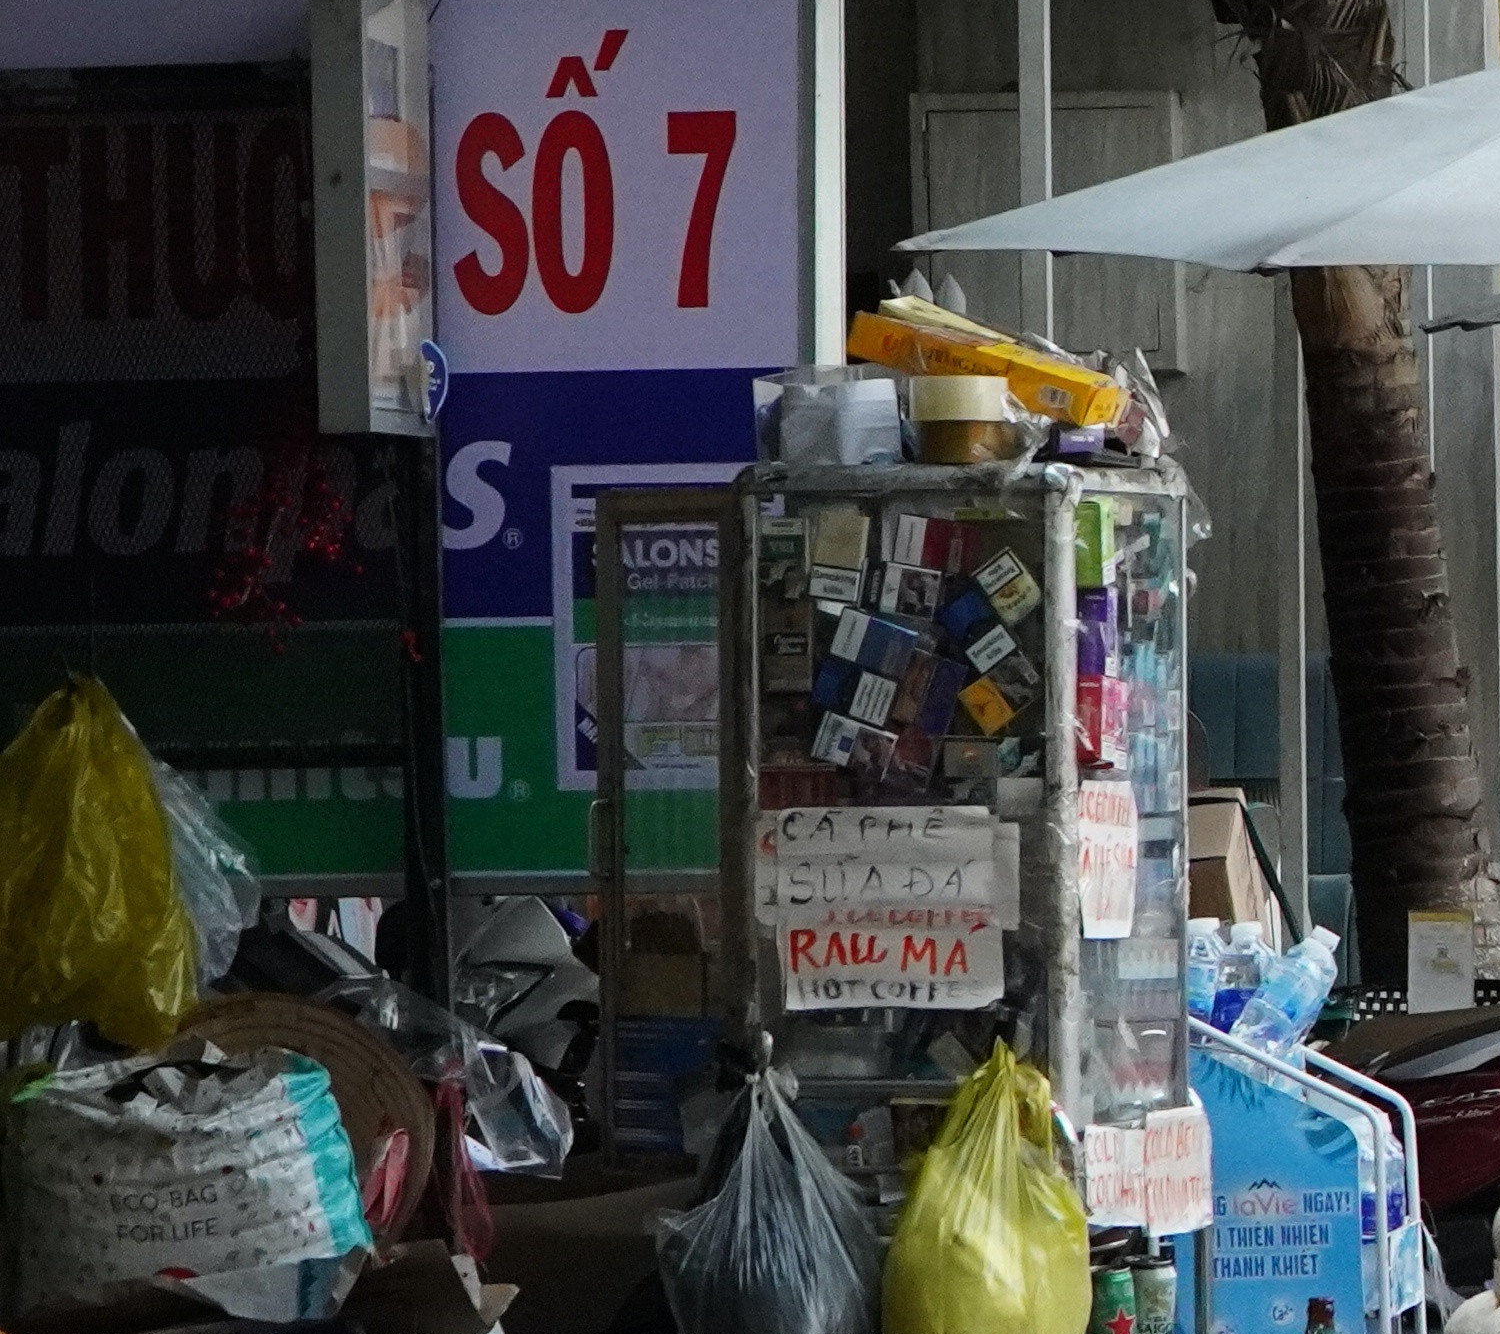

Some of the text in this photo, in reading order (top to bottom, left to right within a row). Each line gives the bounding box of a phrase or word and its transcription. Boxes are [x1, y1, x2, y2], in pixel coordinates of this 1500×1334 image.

[453, 30, 628, 316] SỐ
[667, 111, 738, 308] 7
[111, 1184, 218, 1214] ECO-BAG
[1233, 1194, 1297, 1217] laVie
[1302, 1190, 1350, 1214] NGAY!
[116, 1217, 219, 1245] FOR LIFE
[1228, 1217, 1329, 1249] THIÊN NHIÊN
[1271, 1248, 1318, 1276] KHIẾT
